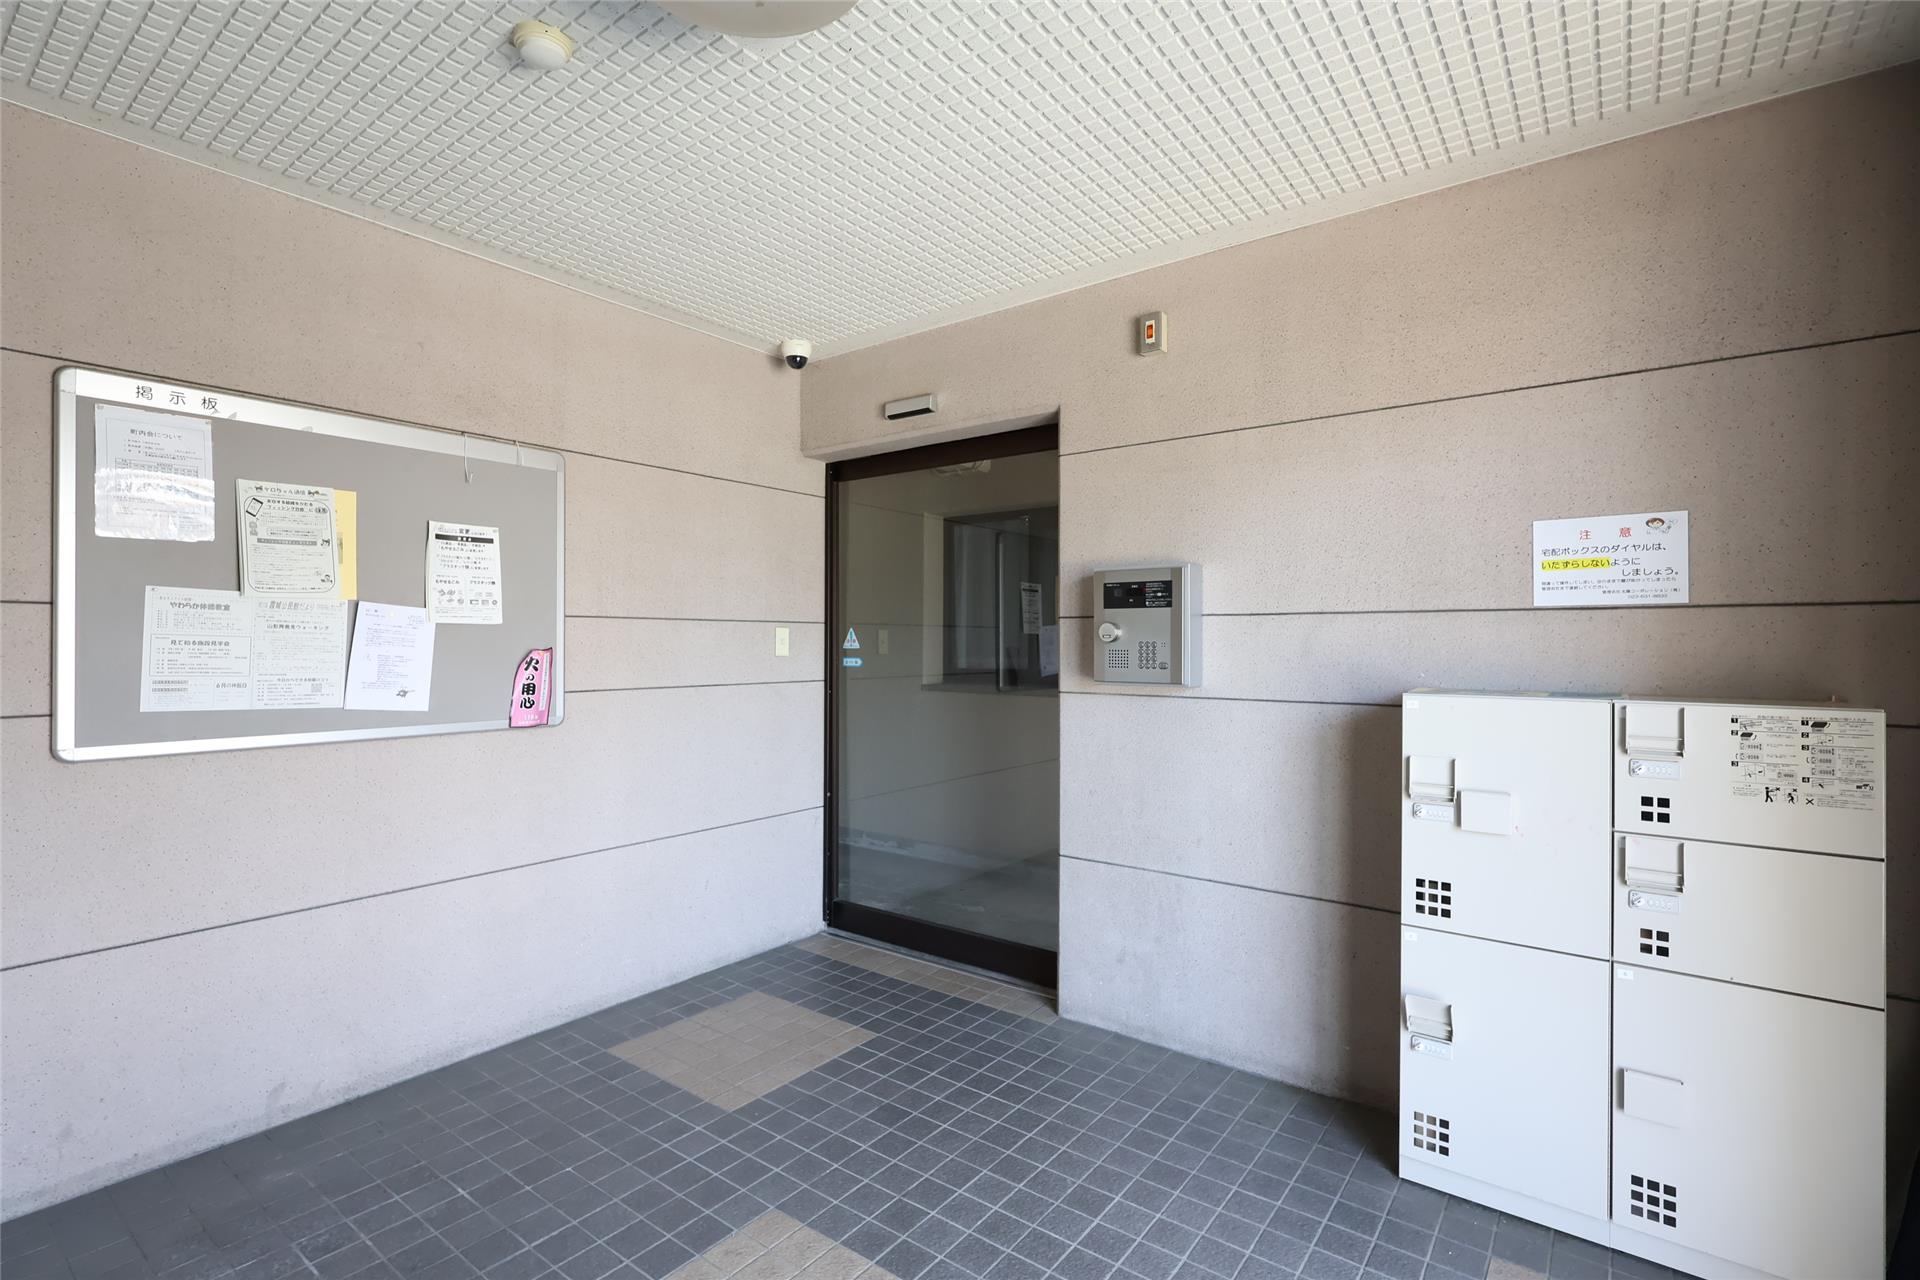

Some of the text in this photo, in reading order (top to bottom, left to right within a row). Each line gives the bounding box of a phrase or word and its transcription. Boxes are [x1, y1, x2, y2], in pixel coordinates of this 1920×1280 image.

[135, 385, 220, 414] 掲示板
[1541, 542, 1668, 557] 宅配ボックスのダイヤルは、
[1541, 557, 1641, 570] いたずらしないように
[1622, 566, 1679, 577] しましょう。
[520, 656, 540, 709] 火の用心
